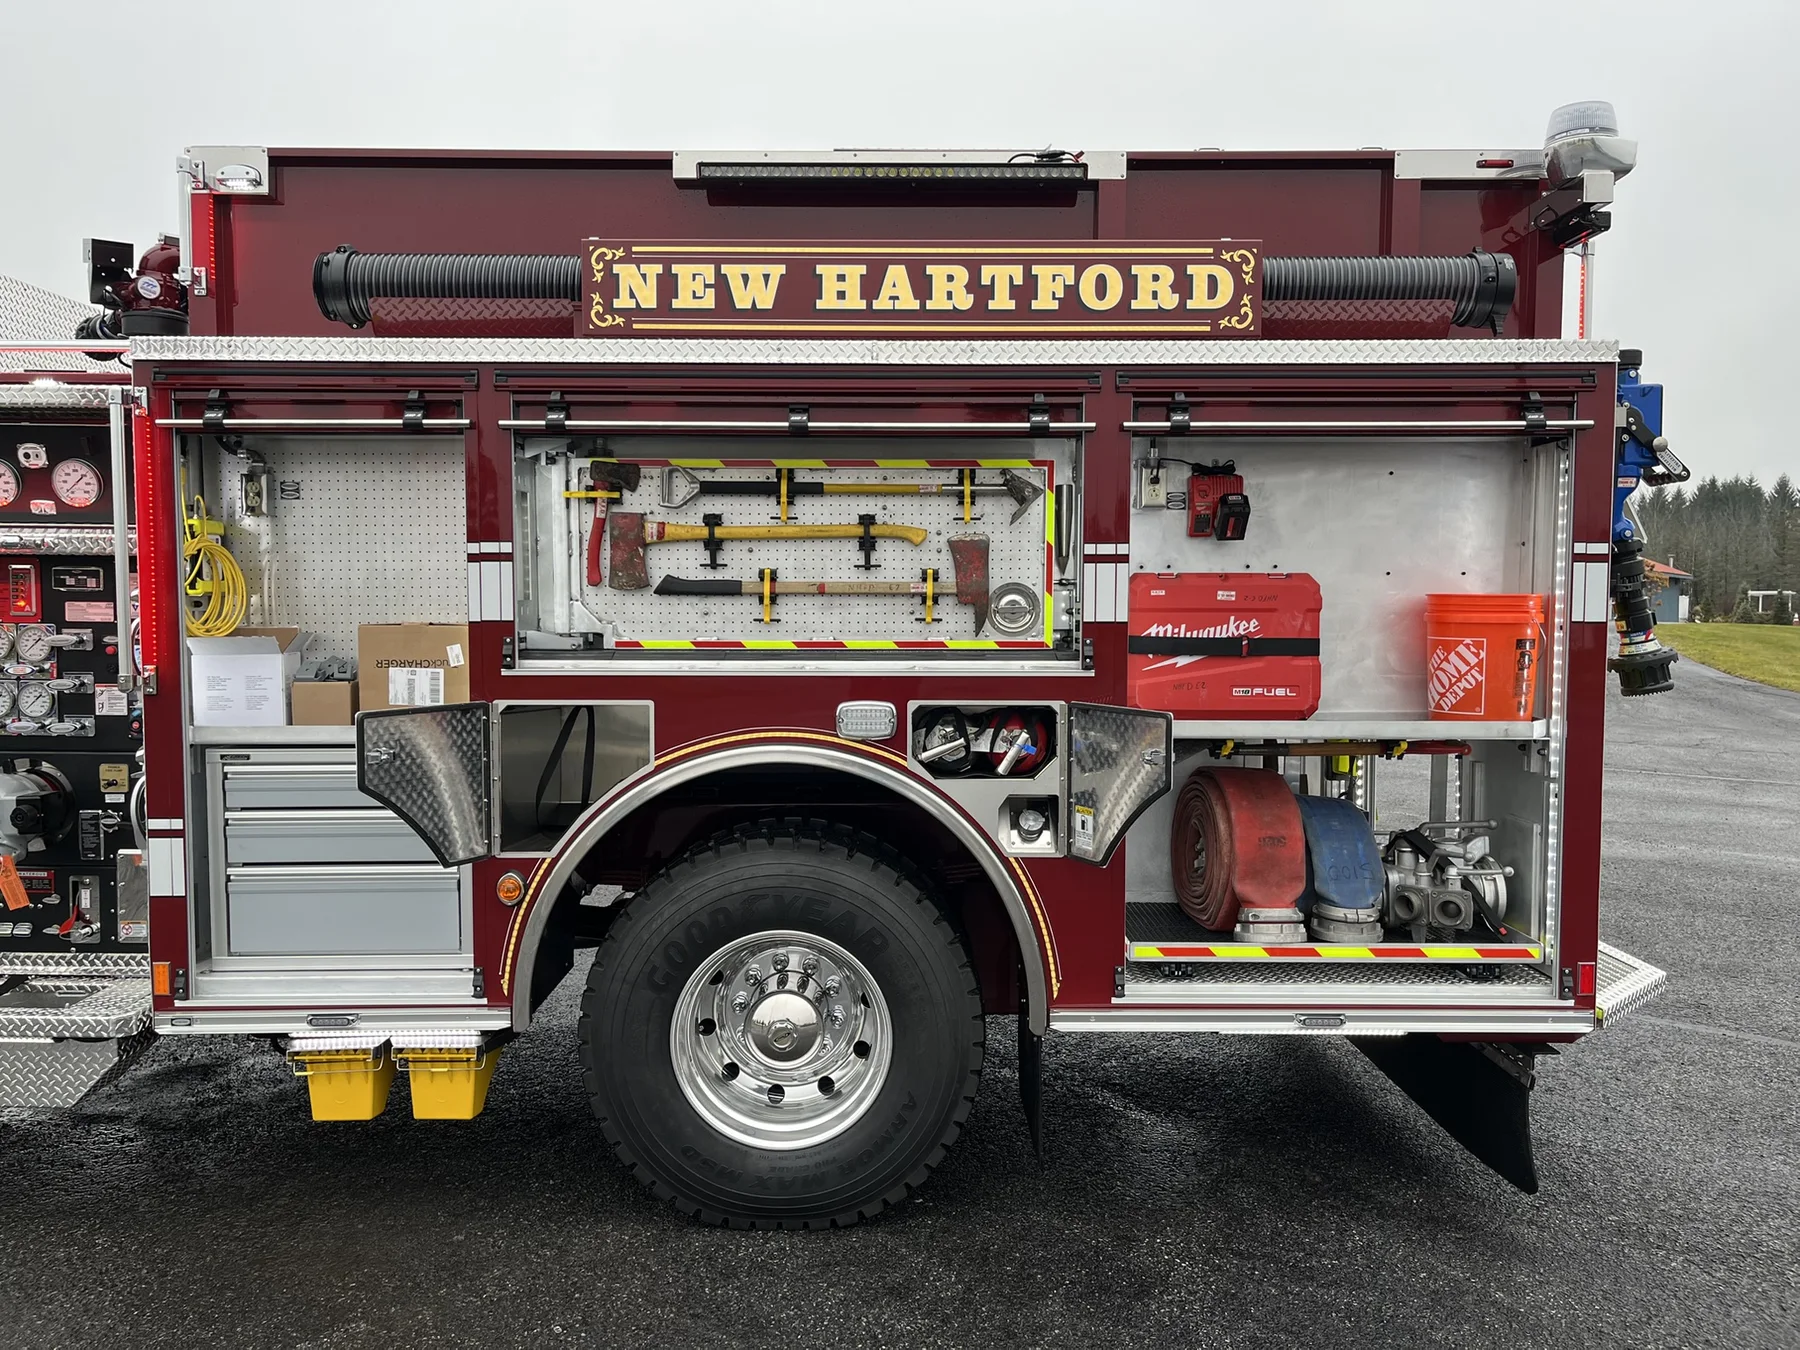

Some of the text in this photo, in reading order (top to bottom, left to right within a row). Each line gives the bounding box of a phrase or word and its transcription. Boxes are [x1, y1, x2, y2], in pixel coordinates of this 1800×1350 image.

[612, 264, 1236, 312] NEW HARTFORD
[1428, 645, 1447, 674] THE
[1428, 639, 1485, 709] HOME
[1252, 688, 1297, 696] FUEL
[1439, 666, 1484, 712] DEPOT
